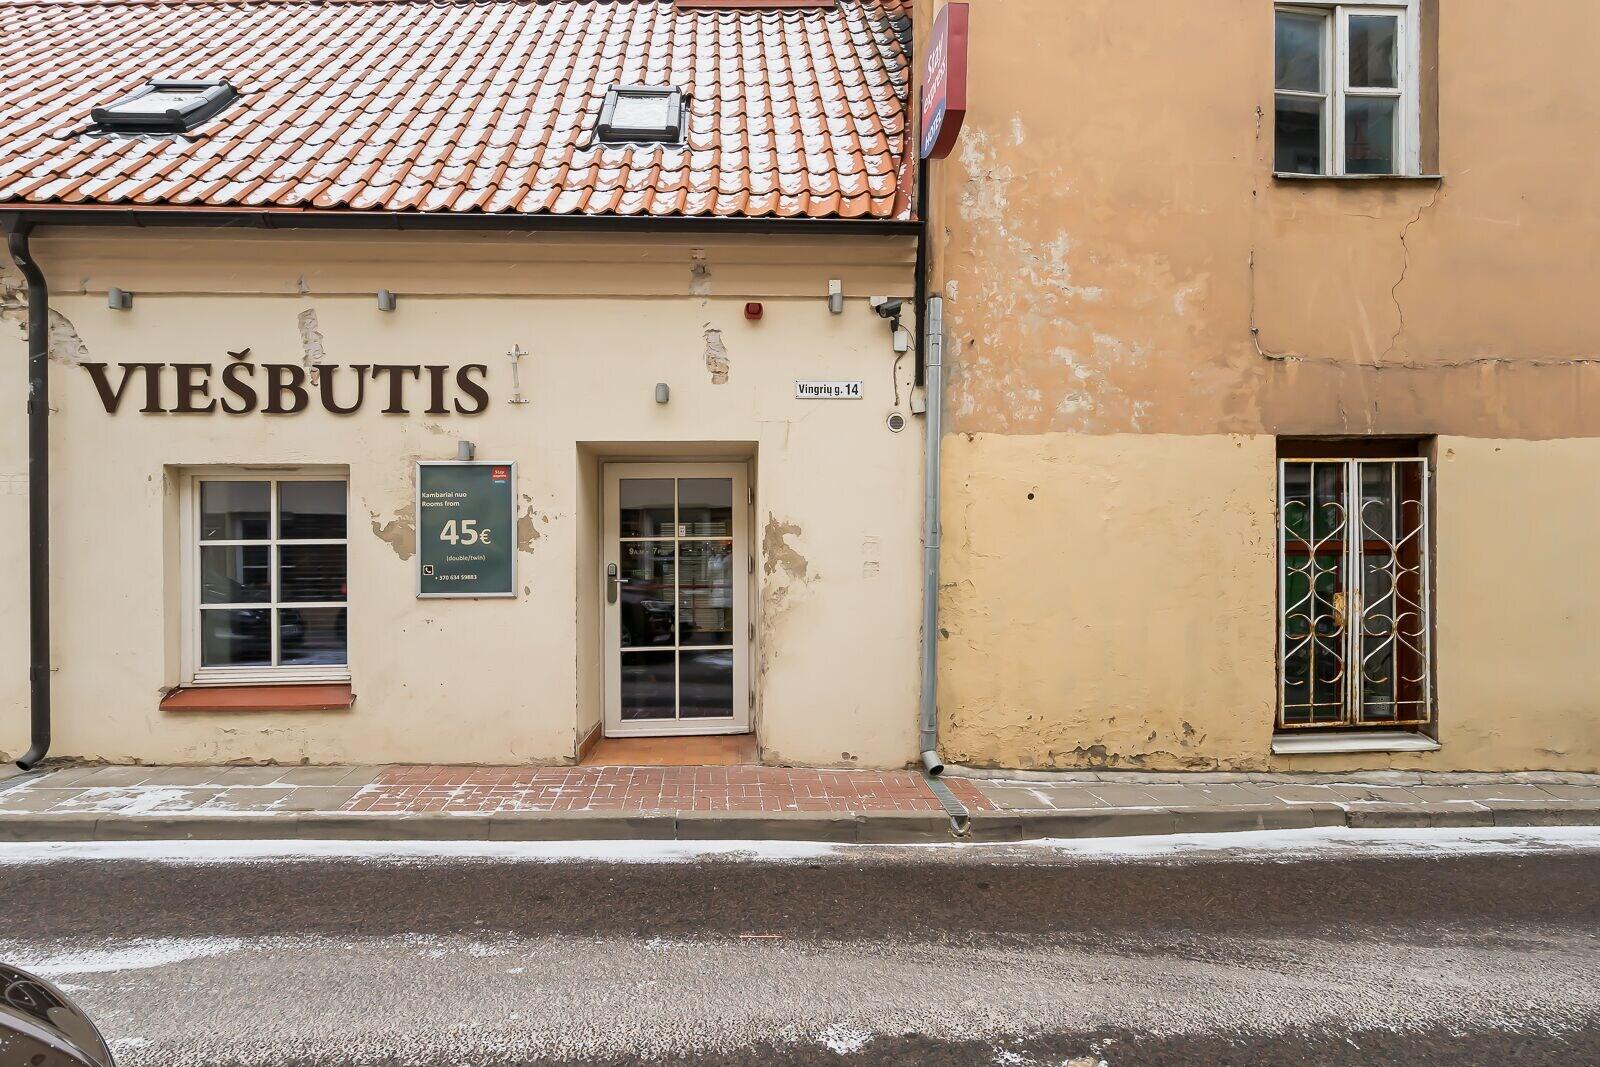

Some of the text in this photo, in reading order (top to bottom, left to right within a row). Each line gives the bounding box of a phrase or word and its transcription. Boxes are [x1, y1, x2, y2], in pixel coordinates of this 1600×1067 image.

[79, 347, 490, 416] VIEŠBUTIS
[798, 383, 859, 396] Vingrių g. 14
[440, 519, 492, 545] 45€
[446, 554, 486, 562] (double/twin)
